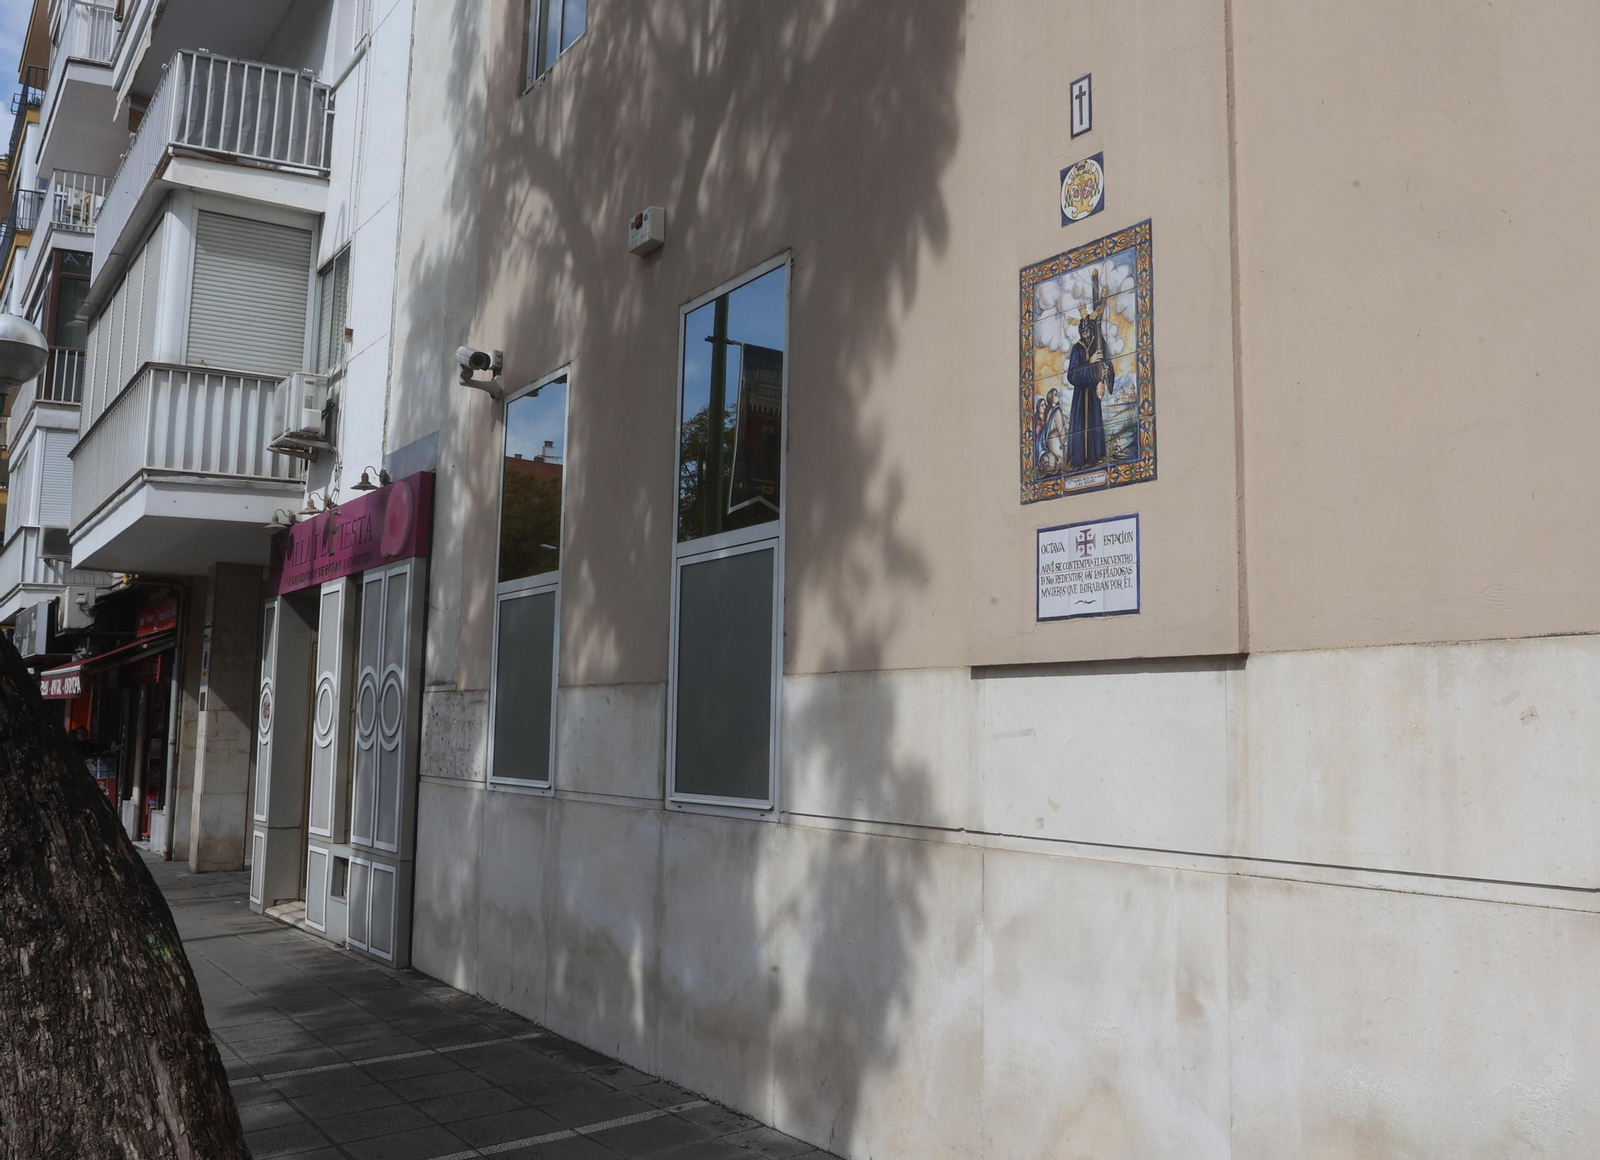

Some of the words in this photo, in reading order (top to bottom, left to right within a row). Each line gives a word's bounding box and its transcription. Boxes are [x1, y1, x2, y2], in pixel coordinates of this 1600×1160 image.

[328, 508, 372, 556] FIESTA
[1041, 542, 1065, 554] OCTAVA
[1055, 563, 1062, 571] SE
[1094, 558, 1100, 567] EL
[1054, 572, 1084, 585] REDENTOR
[1079, 580, 1109, 594] LLORABAN
[1110, 579, 1123, 590] POR
